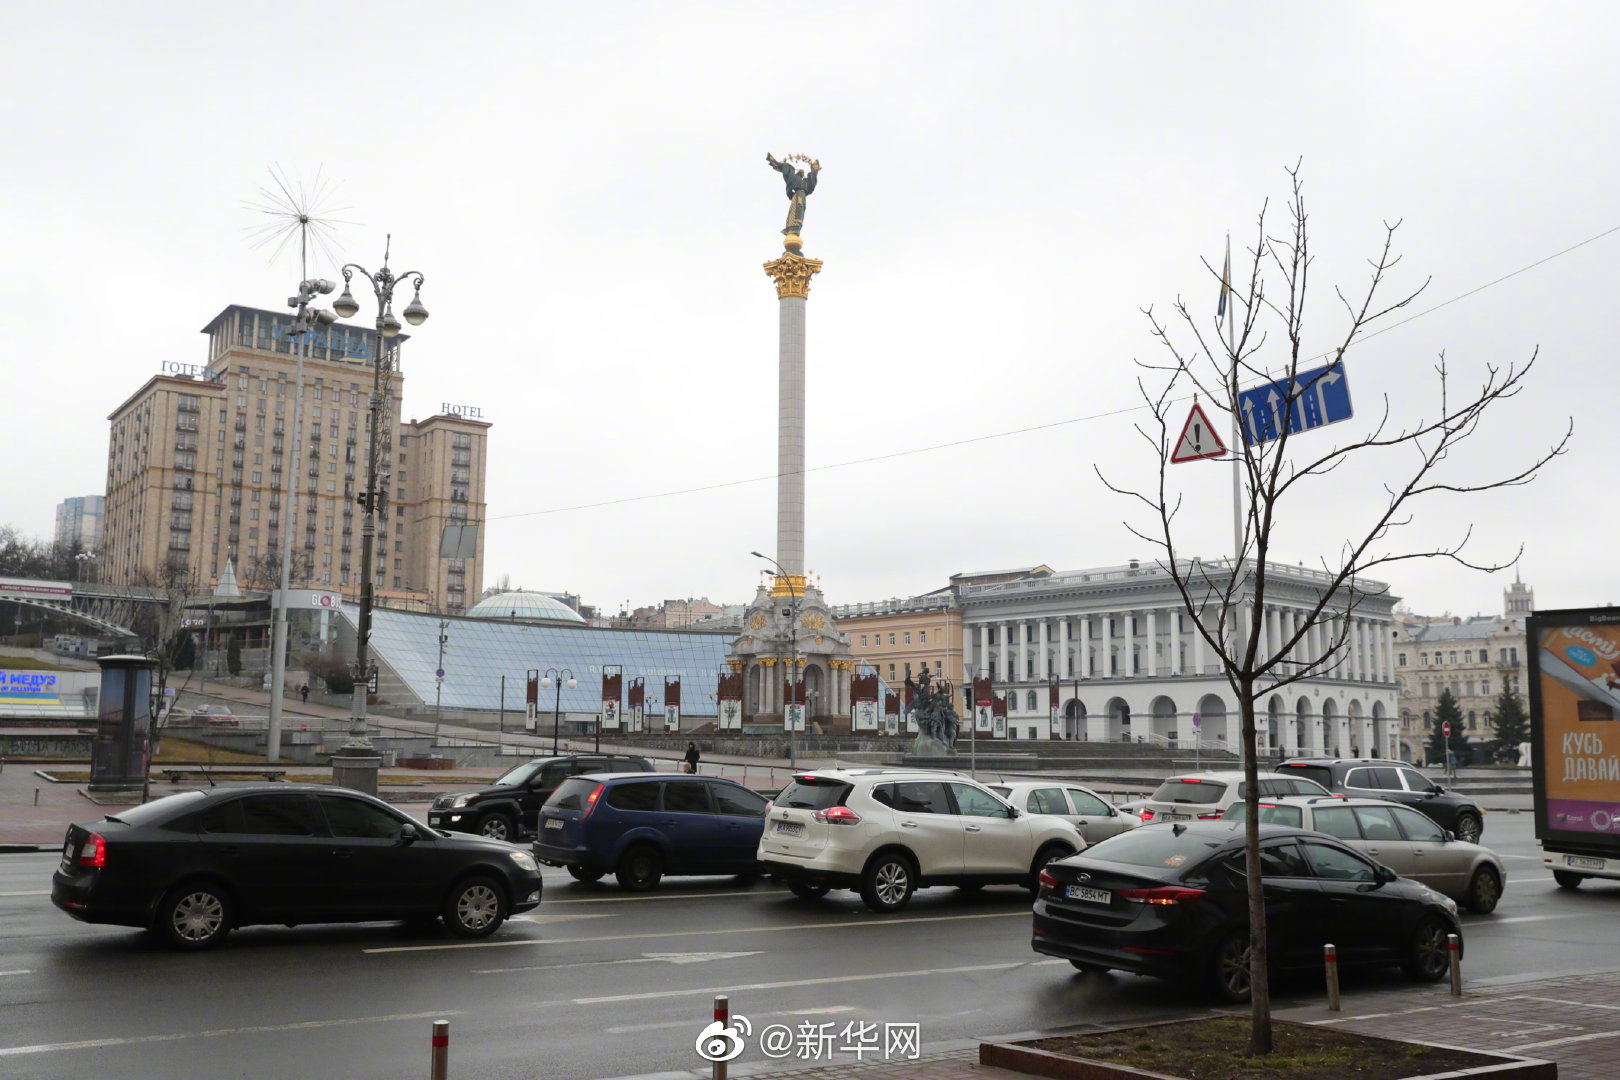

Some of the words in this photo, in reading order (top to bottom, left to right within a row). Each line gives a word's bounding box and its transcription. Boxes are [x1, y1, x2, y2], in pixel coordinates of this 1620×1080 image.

[441, 402, 484, 418] HOTEL
[11, 673, 57, 687] МЕДУЗ
[1562, 732, 1602, 755] КУСЬ
[1562, 755, 1620, 782] ДАВАЙ
[1070, 886, 1080, 897] BC
[1080, 888, 1097, 900] 5854
[1097, 891, 1110, 902] MT
